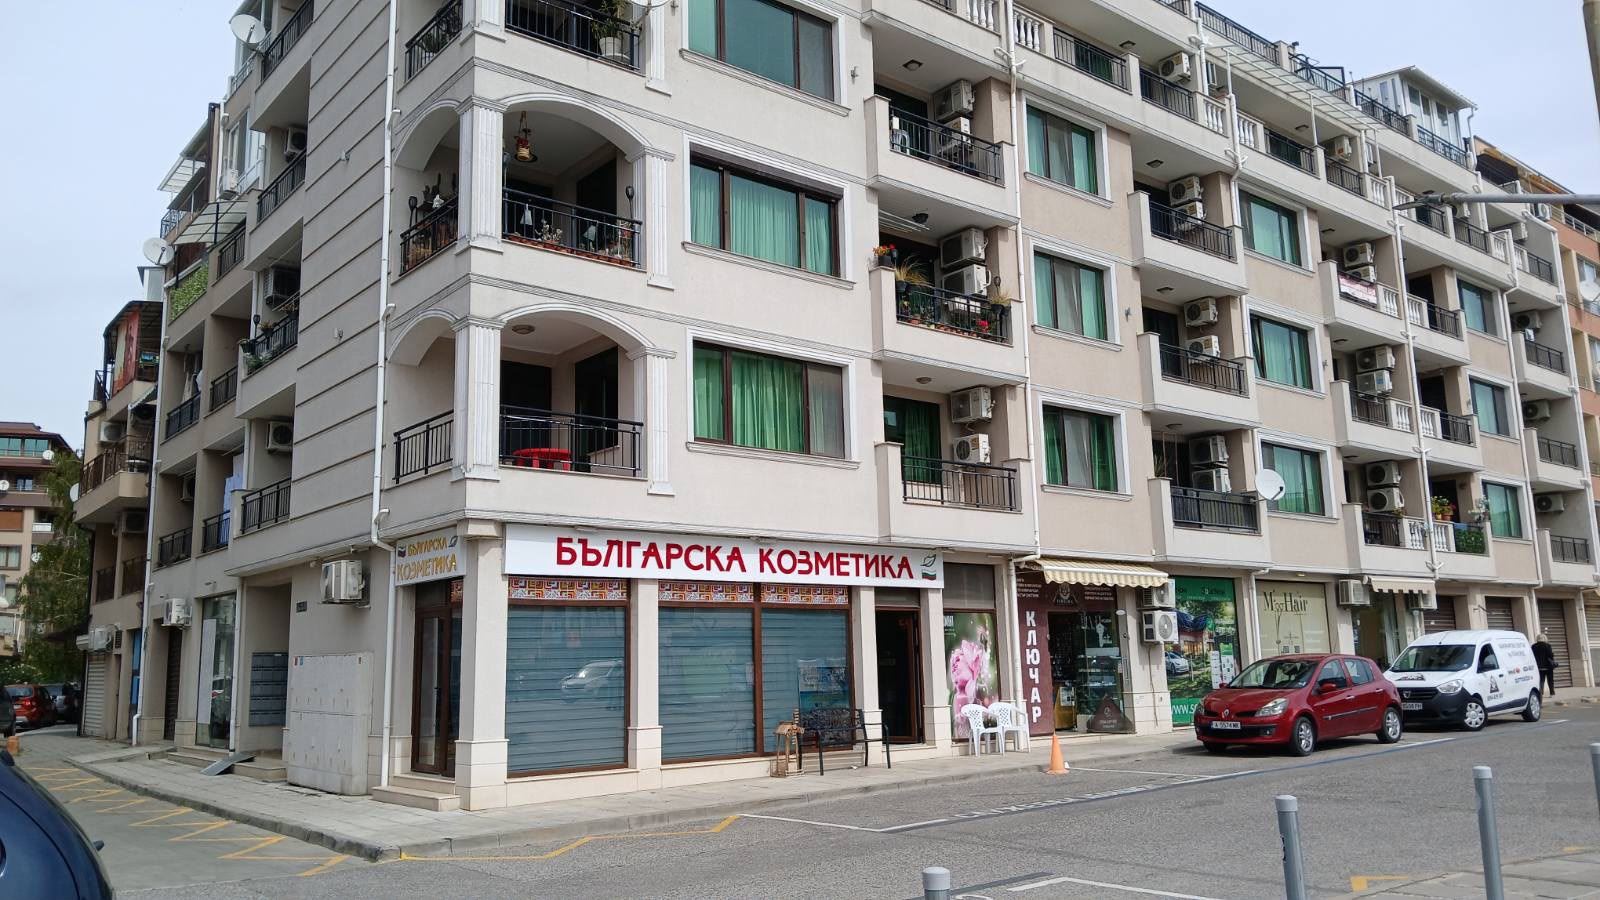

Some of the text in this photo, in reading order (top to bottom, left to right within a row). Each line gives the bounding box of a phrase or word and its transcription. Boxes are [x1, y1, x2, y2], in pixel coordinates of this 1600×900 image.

[396, 553, 457, 581] КОЗМЕТИКА
[556, 536, 914, 579] БЪЛГАРСКА КОЗМЕТИКА
[1026, 610, 1042, 723] КЛЮЧАР
